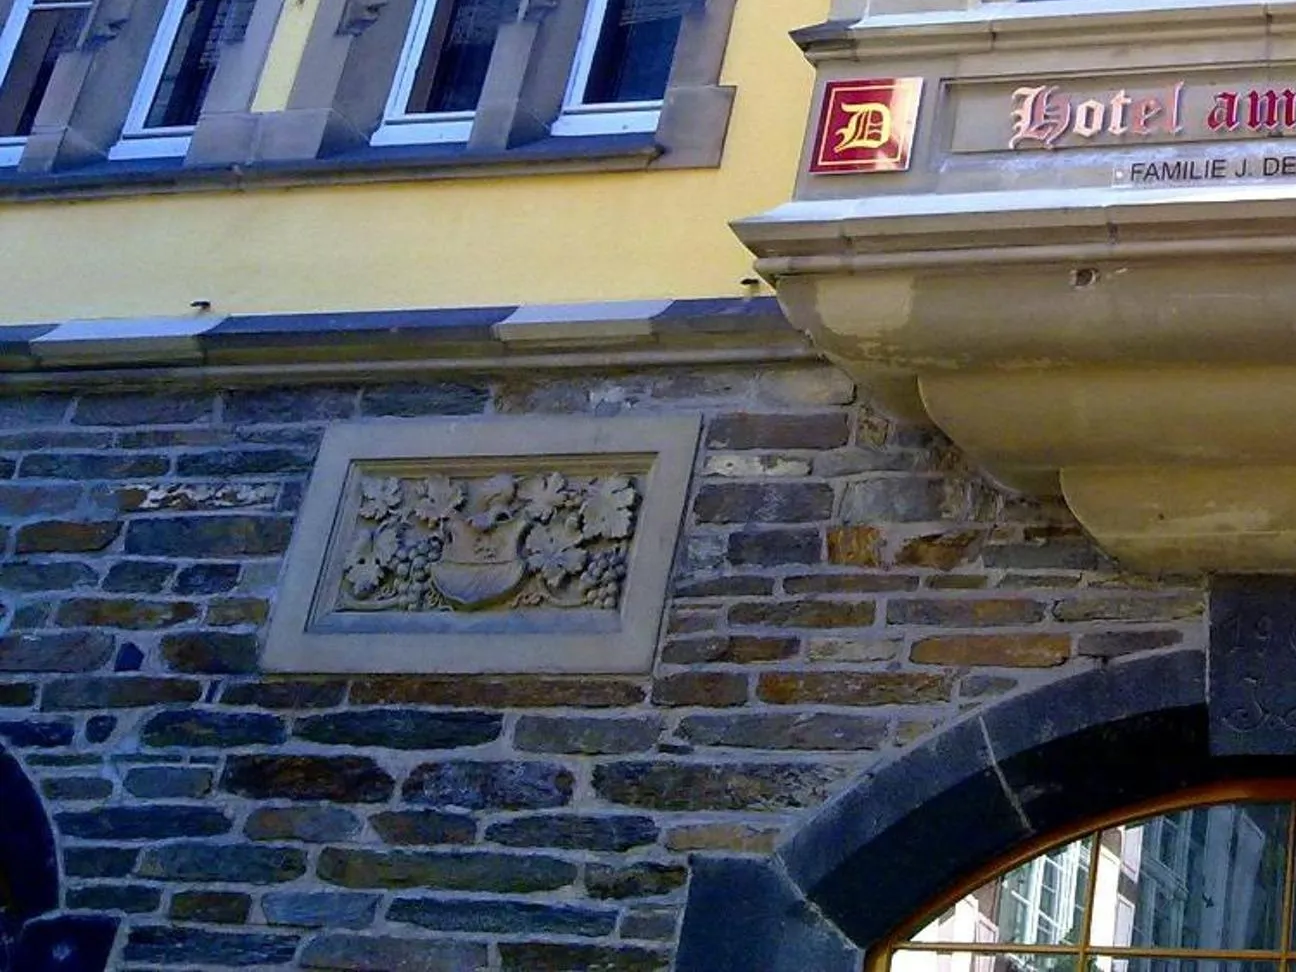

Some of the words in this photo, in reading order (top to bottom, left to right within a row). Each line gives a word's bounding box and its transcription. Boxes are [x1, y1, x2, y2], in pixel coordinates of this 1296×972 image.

[834, 102, 892, 153] D
[1008, 81, 1184, 150] Hotel
[1130, 158, 1226, 182] FAMILIE
[1234, 158, 1253, 178] J.
